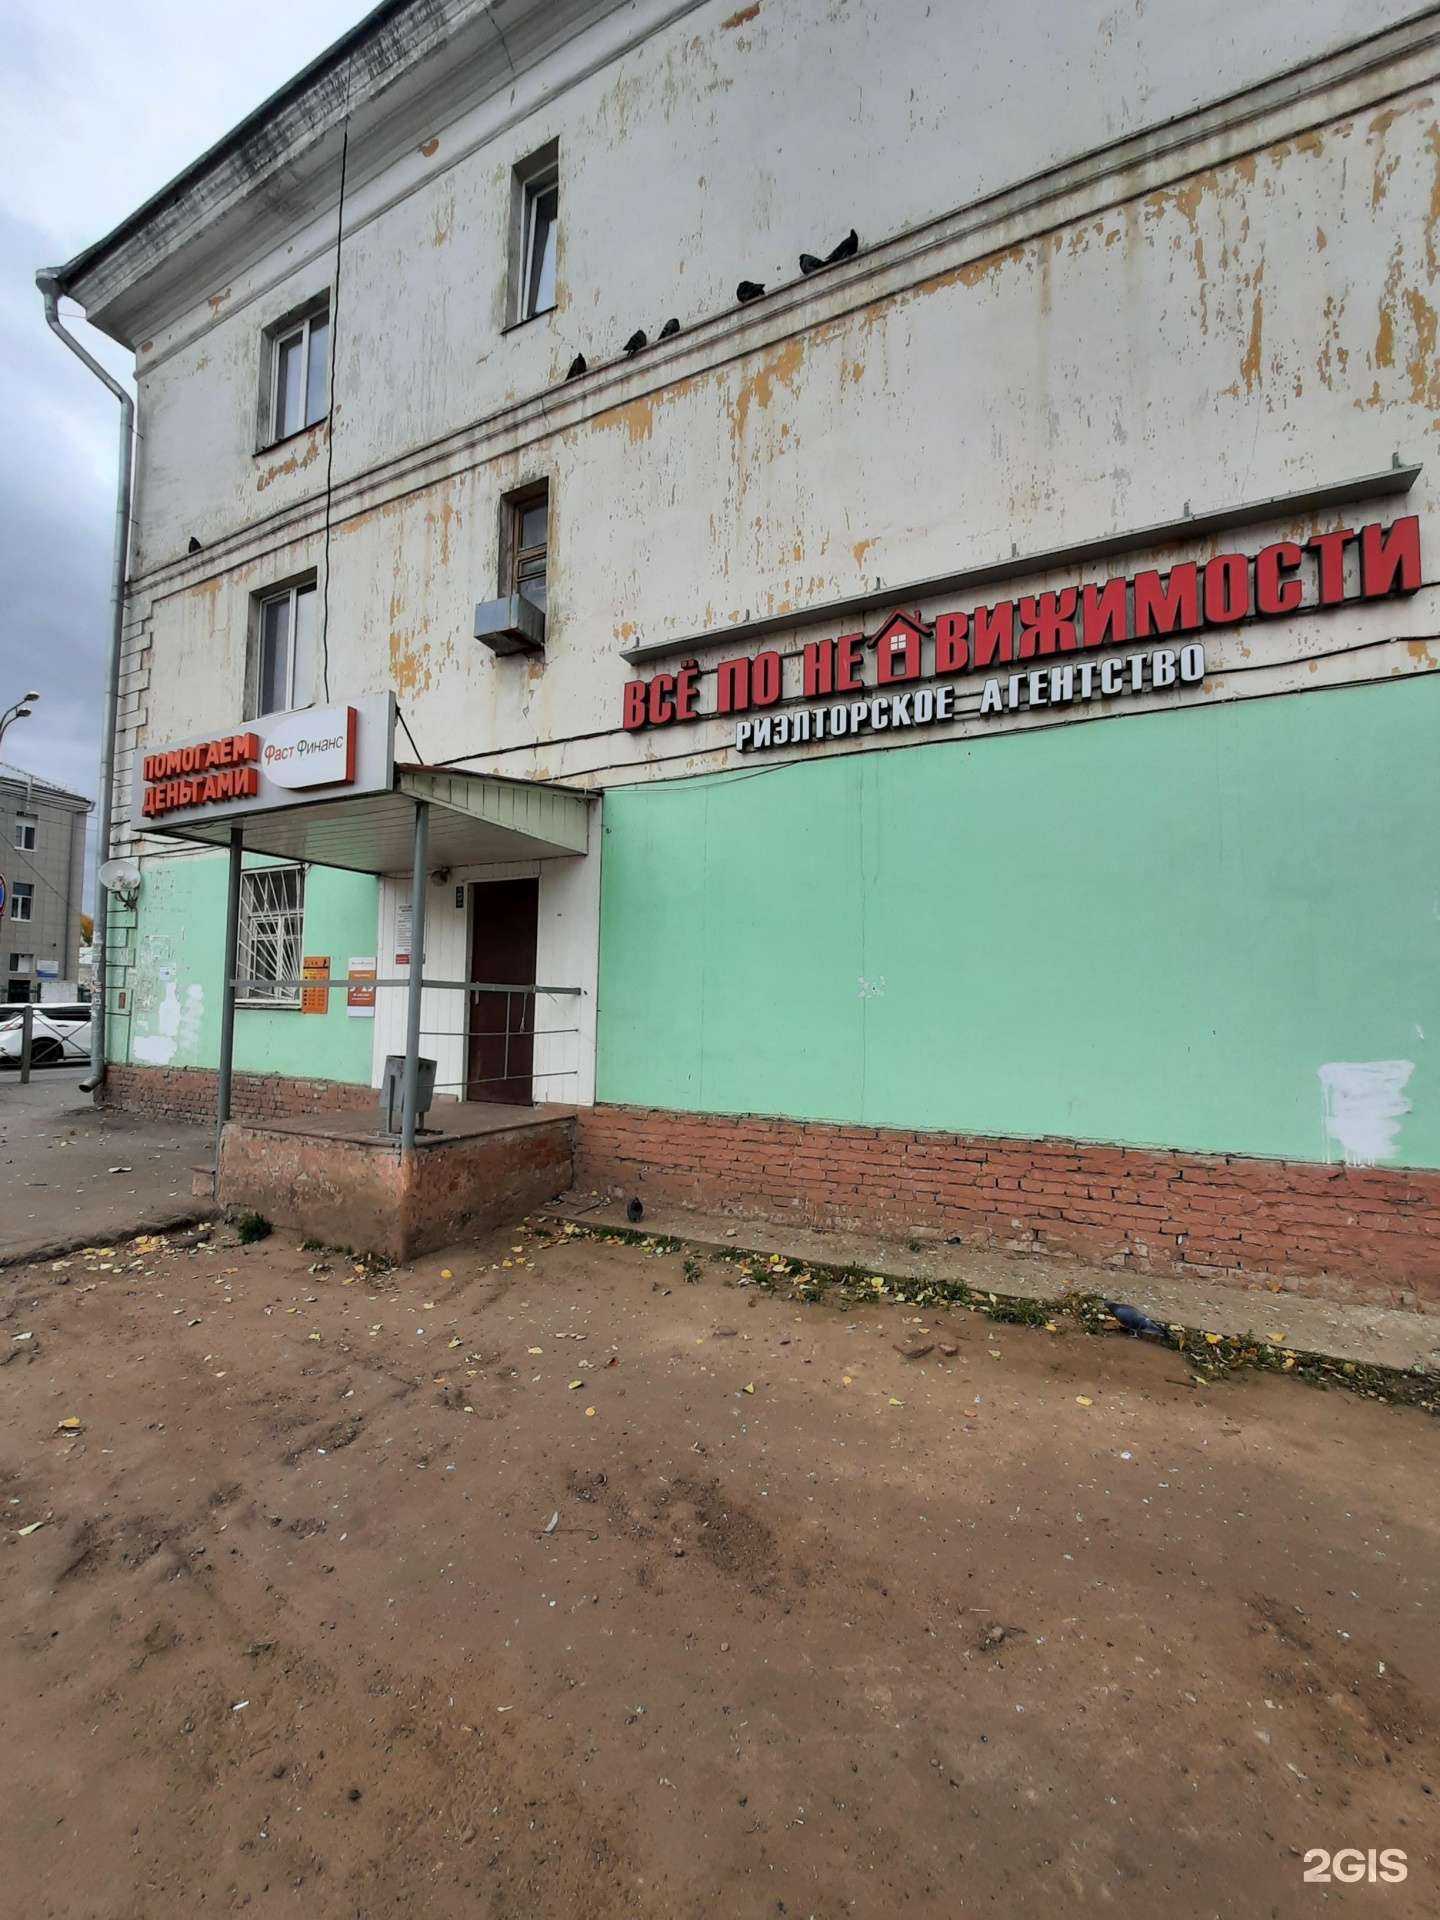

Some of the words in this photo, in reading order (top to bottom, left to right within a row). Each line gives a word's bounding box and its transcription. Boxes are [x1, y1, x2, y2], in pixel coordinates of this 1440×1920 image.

[623, 659, 699, 730] ВСЁ
[717, 650, 782, 714] ПО
[735, 685, 954, 752] РИЭЛТОРСКОЕ
[980, 643, 1206, 714] АГЕНТСТВО
[143, 732, 259, 782] ПОМОГАЕМ
[264, 744, 294, 765] Фаст
[296, 735, 343, 755] Финанс
[142, 767, 258, 818] ДЕНЬГАМИ
